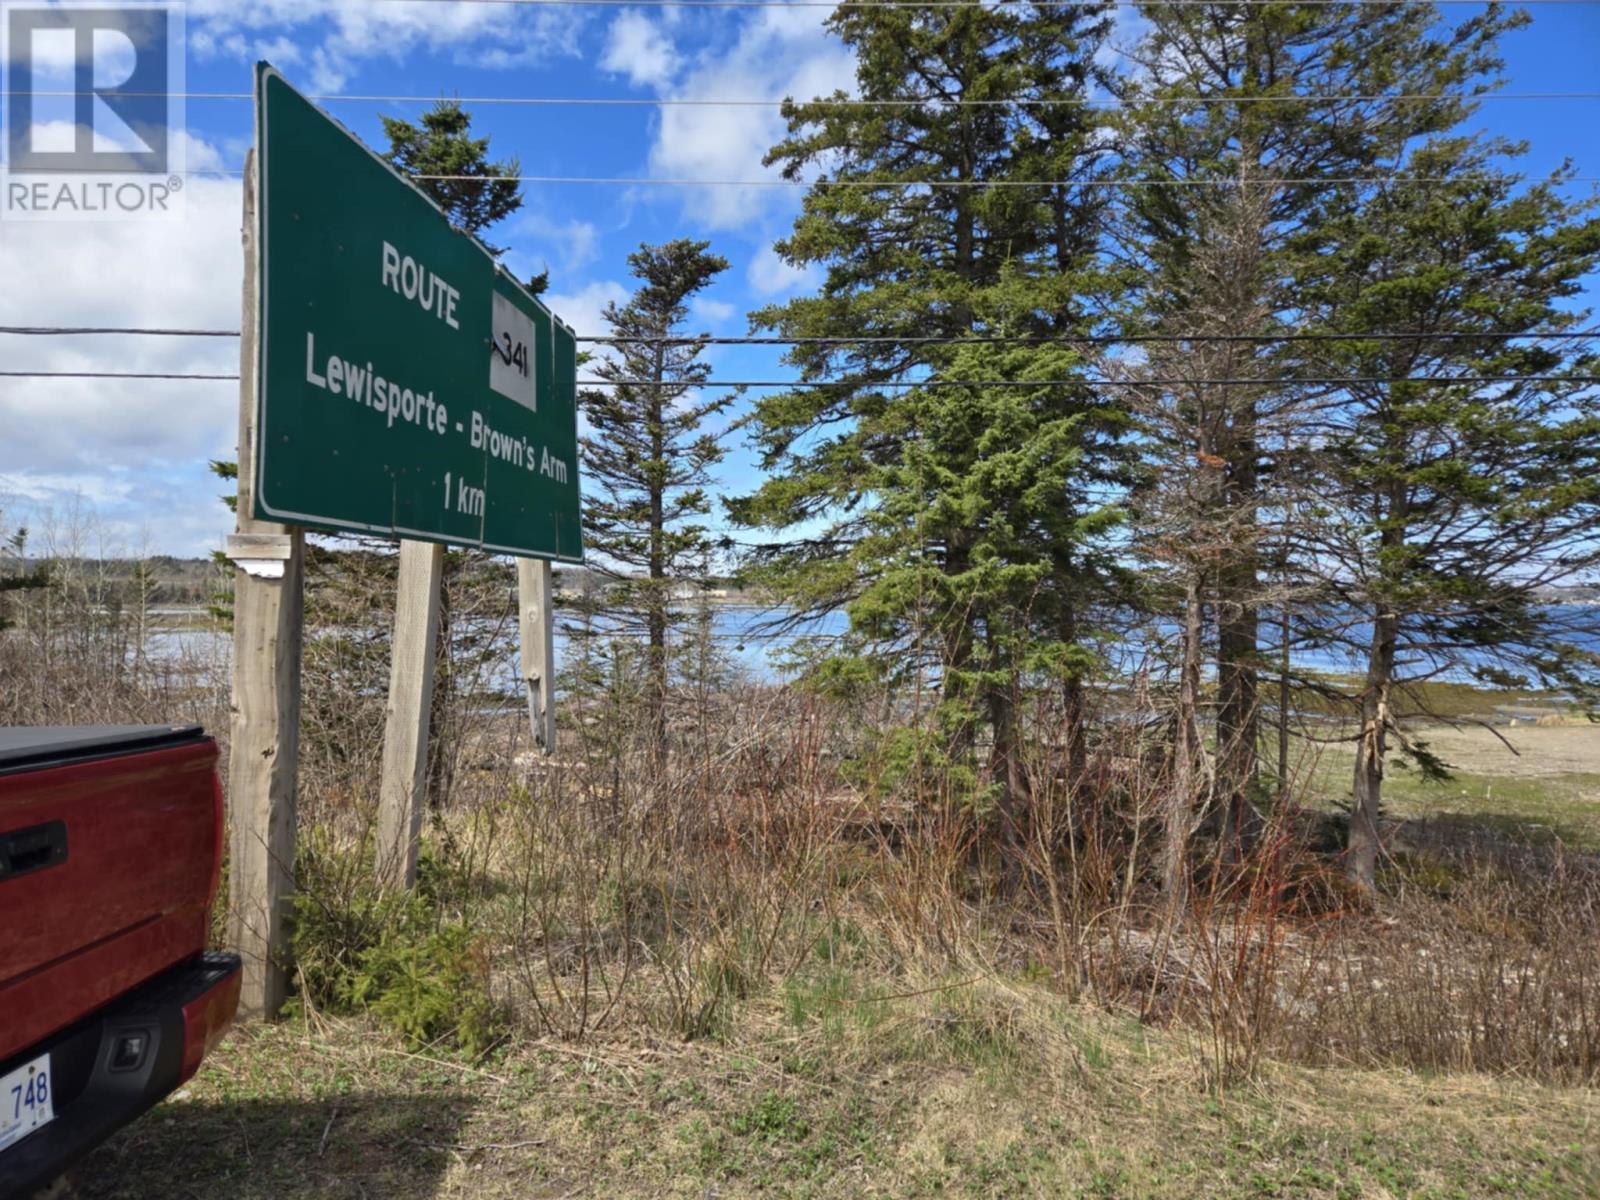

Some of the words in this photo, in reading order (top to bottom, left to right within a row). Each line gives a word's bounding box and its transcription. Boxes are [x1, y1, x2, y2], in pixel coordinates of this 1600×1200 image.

[382, 240, 460, 330] ROUTE
[502, 331, 529, 378] 341
[306, 331, 448, 435] Lewisporte
[470, 410, 535, 471] Brown's
[540, 446, 568, 484] Arm
[443, 471, 451, 510] 1
[458, 476, 485, 517] km
[11, 1072, 48, 1119] 748
